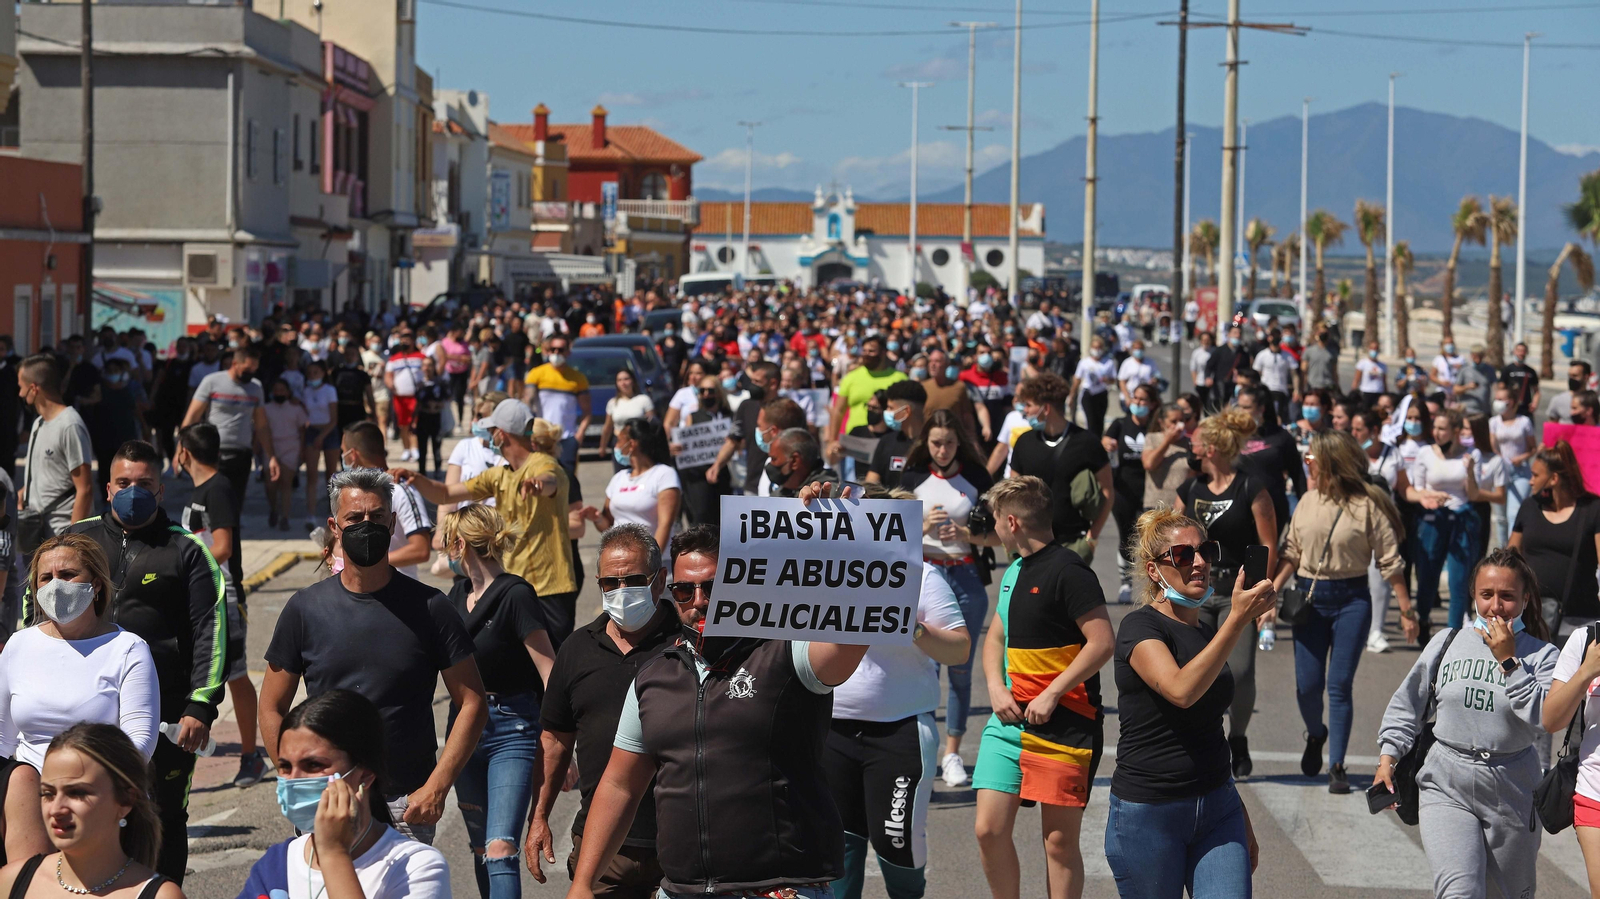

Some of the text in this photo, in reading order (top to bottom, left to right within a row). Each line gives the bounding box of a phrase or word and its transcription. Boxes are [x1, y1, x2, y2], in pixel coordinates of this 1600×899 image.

[692, 436, 725, 449] ABUSO
[714, 423, 727, 432] YA
[740, 510, 907, 544] ¡BASTA YA
[722, 557, 908, 589] DE ABUSOS
[712, 600, 912, 635] POLICIALES!
[1441, 658, 1507, 689] BROOKL
[1464, 686, 1495, 712] USA
[884, 775, 911, 849] ellesse
